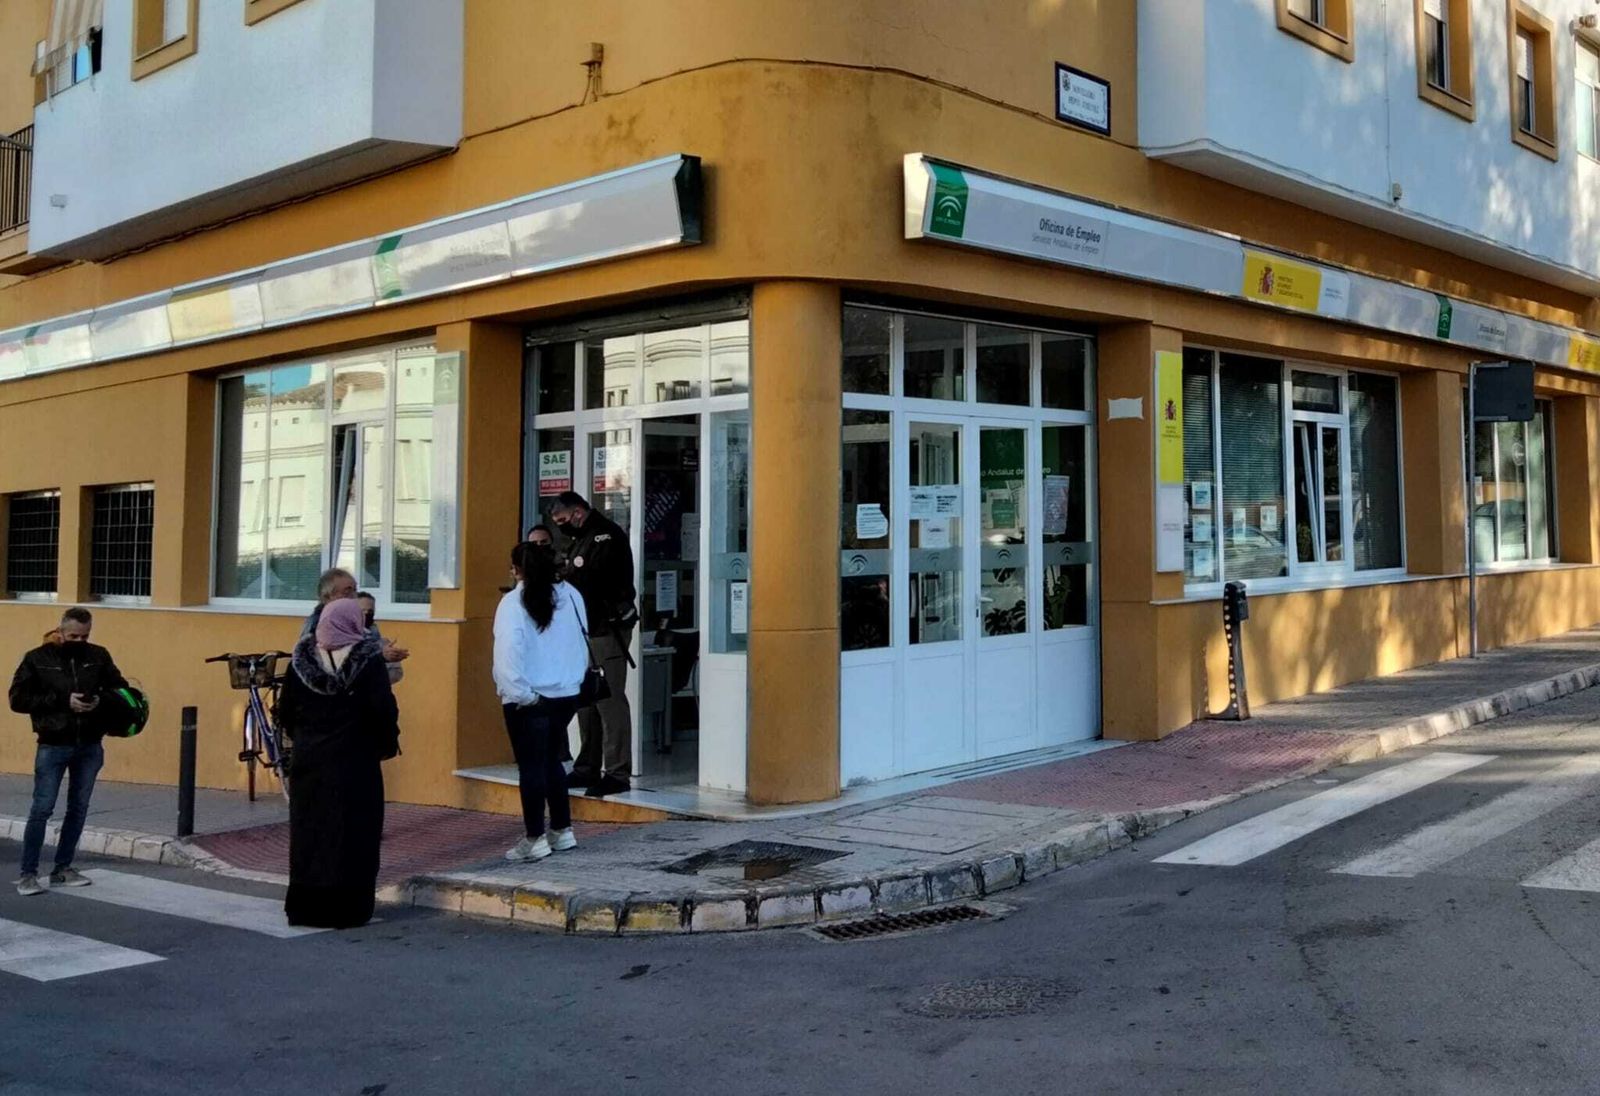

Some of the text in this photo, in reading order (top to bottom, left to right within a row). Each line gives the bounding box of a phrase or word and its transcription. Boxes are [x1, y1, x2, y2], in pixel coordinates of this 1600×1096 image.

[1040, 218, 1101, 243] Oficina de Empleo
[543, 453, 567, 465] SAE
